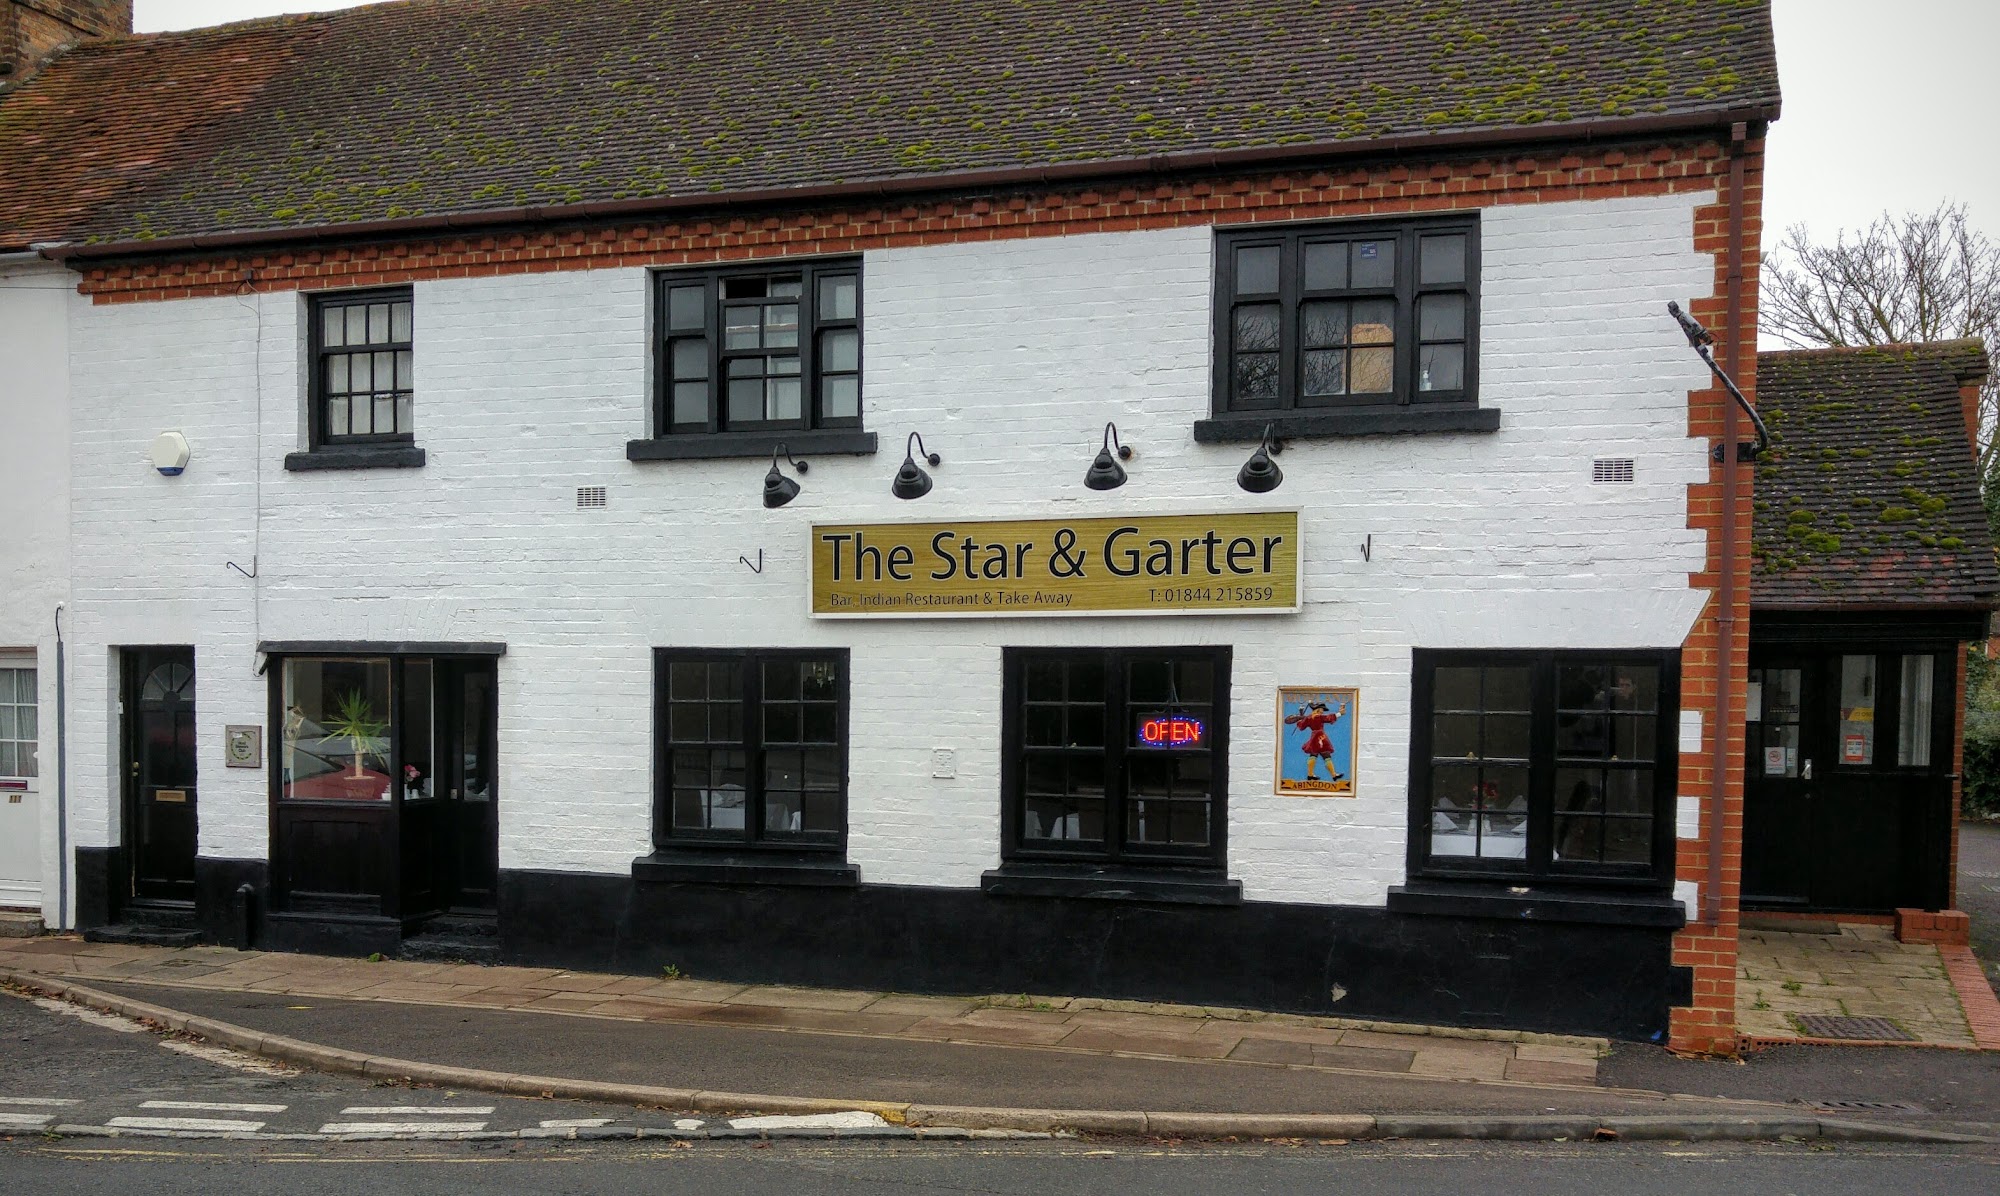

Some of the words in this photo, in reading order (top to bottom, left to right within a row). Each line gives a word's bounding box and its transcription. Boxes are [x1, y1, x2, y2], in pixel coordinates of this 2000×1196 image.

[821, 531, 914, 581] The
[930, 530, 1033, 580] Star
[1048, 527, 1088, 578] &
[1102, 526, 1282, 577] Garter
[831, 593, 856, 608] Bar,
[860, 592, 900, 606] Indian
[906, 592, 979, 606] Restaurant
[983, 591, 993, 605] &
[996, 591, 1030, 604] Take
[1033, 591, 1073, 607] Away
[1149, 588, 1160, 602] T:
[1165, 588, 1211, 602] 01844
[1216, 586, 1273, 601] 215859
[1144, 721, 1200, 741] OPEN
[1292, 781, 1338, 790] ABINGDON
